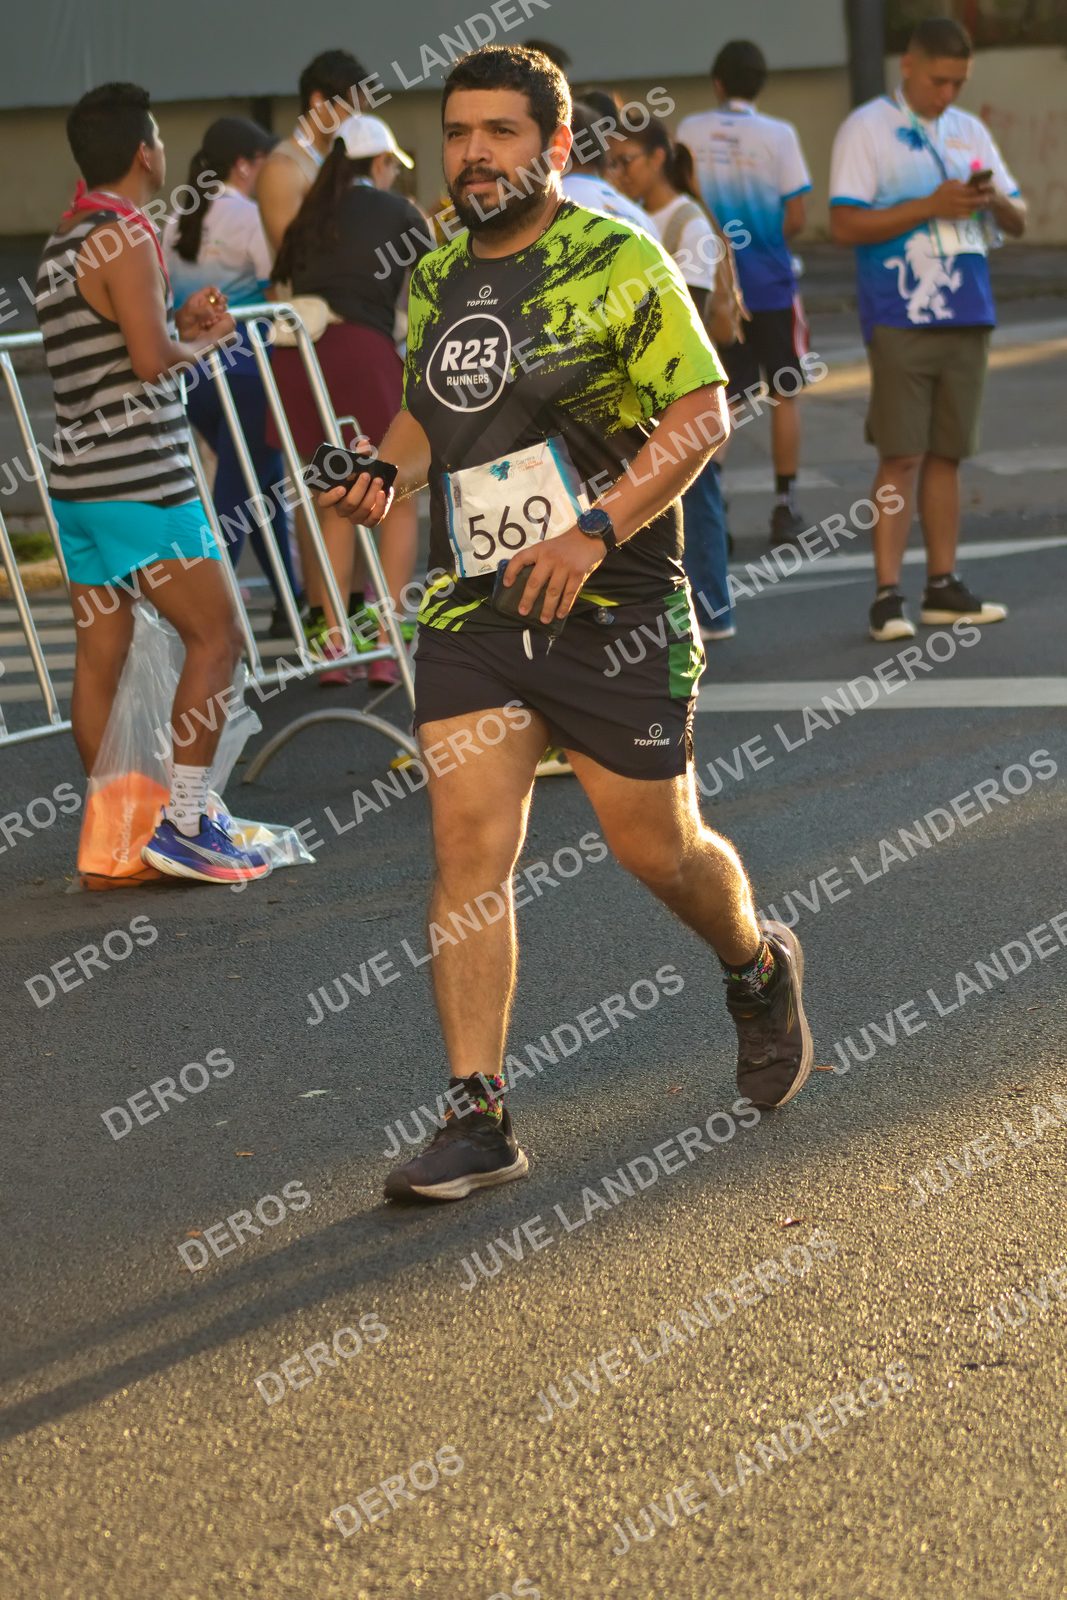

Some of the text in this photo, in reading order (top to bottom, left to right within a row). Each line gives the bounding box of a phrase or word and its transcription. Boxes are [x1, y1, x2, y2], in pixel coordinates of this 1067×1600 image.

[466, 299, 499, 307] TOPTIME
[440, 337, 499, 372] R23
[446, 373, 489, 386] RUNNERS
[468, 495, 552, 561] 569
[633, 737, 670, 747] TOPTIME
